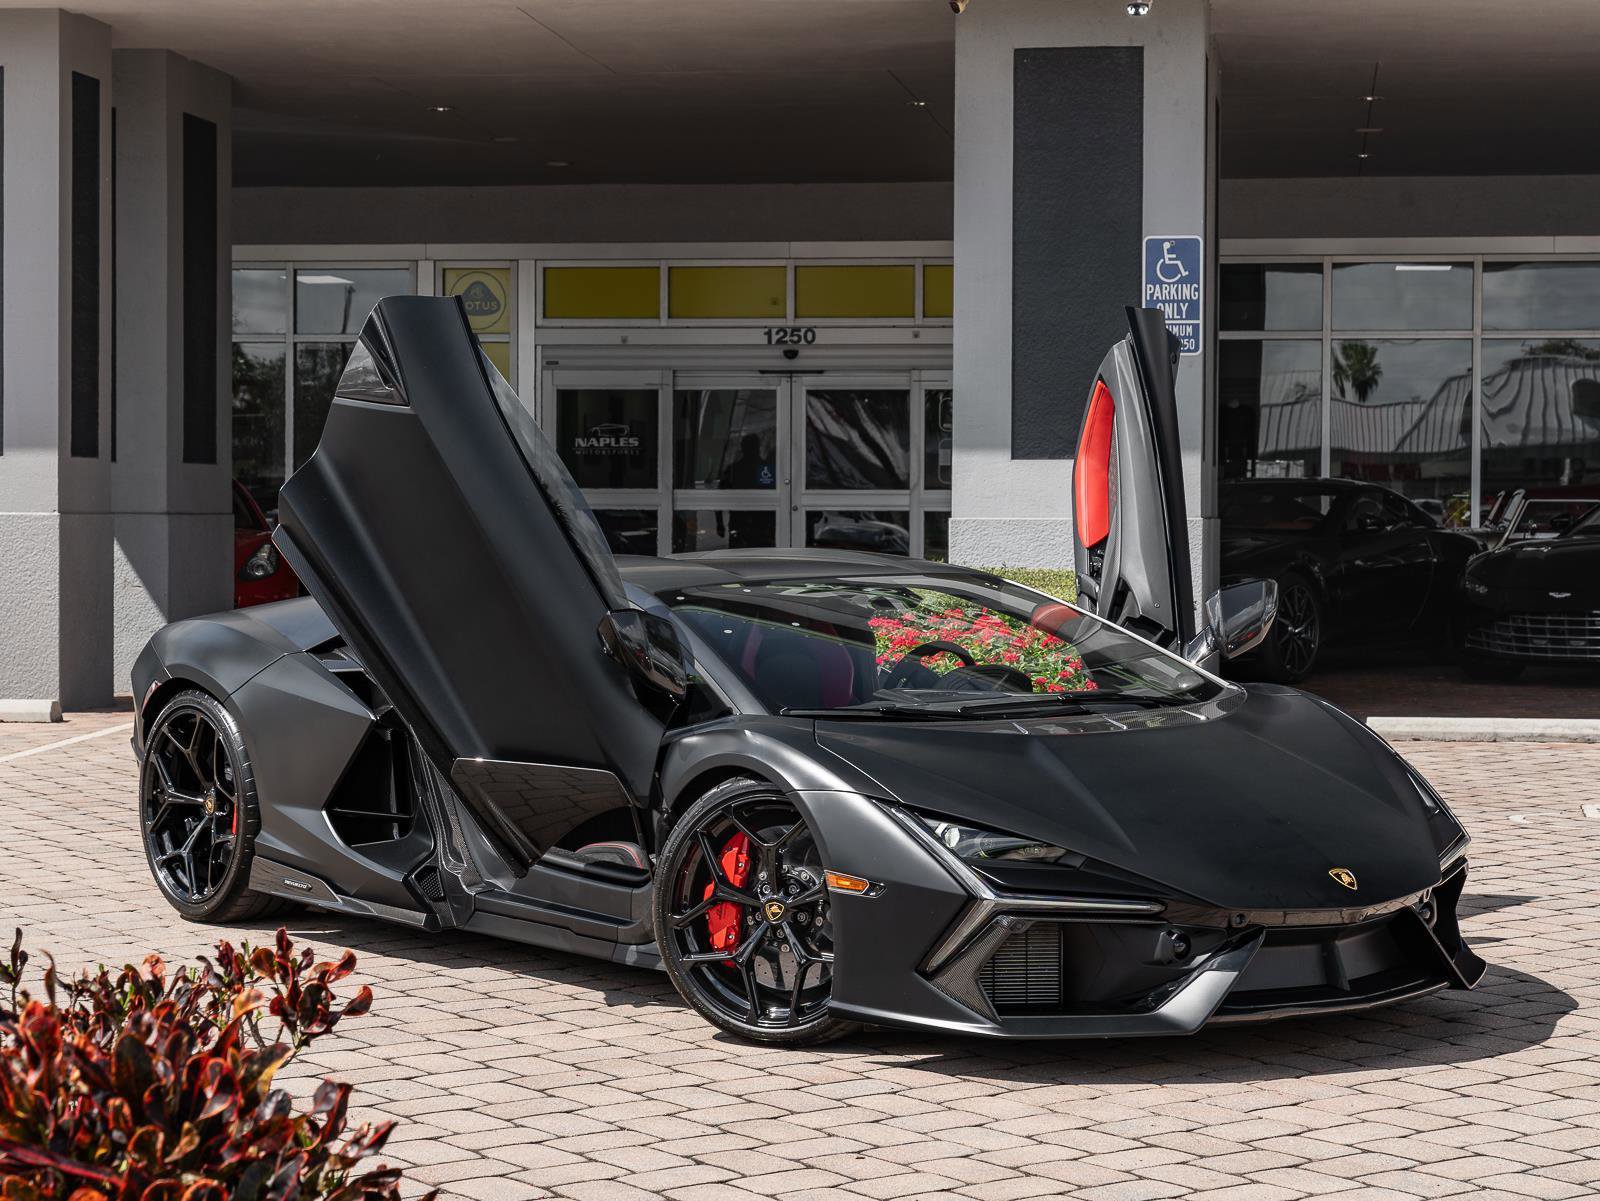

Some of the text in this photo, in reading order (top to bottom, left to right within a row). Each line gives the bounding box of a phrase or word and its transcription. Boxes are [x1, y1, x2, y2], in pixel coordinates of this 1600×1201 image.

[1146, 284, 1199, 300] PARKING
[464, 301, 498, 311] OTUS
[763, 327, 816, 345] 1250
[575, 437, 640, 448] NAPLES
